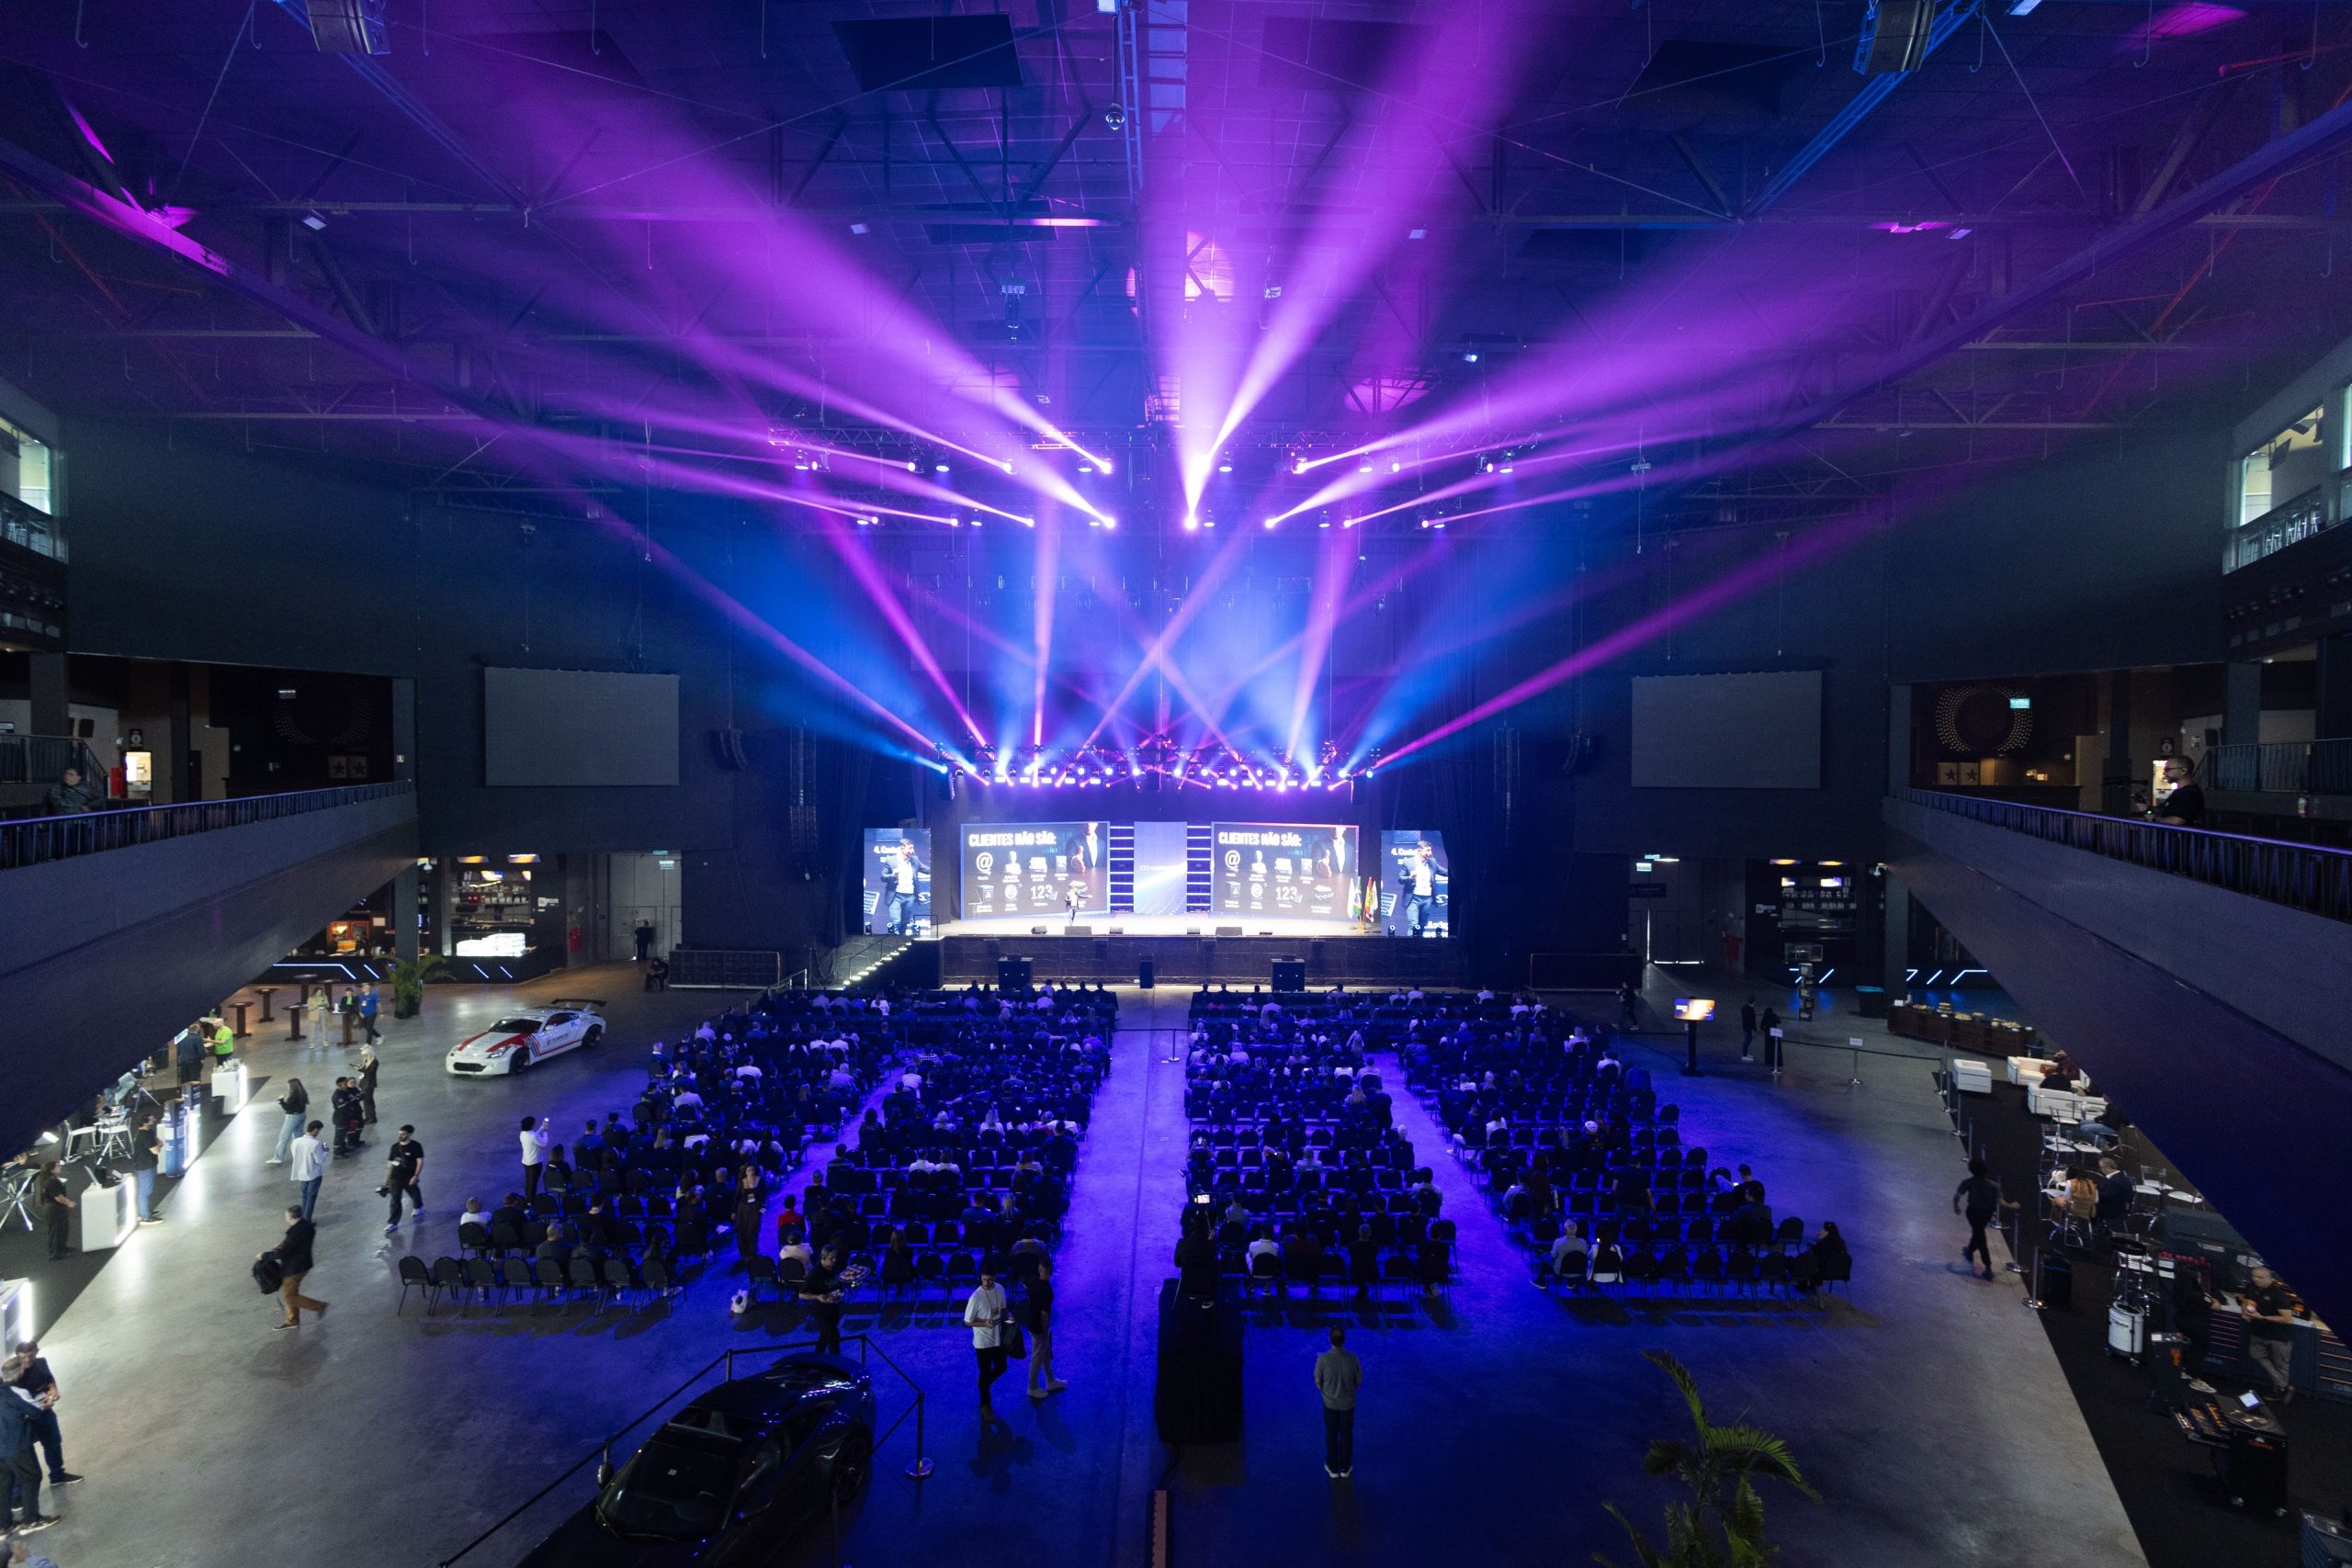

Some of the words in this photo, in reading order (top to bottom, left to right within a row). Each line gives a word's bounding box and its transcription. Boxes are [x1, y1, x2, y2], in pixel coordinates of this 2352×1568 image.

[969, 833, 1013, 847] CLIENTES
[1015, 831, 1035, 845] NÃO
[1218, 832, 1260, 845] CLIENTES
[1261, 831, 1280, 846] NÃO
[1031, 885, 1053, 899] 123
[1275, 886, 1298, 900] 123
